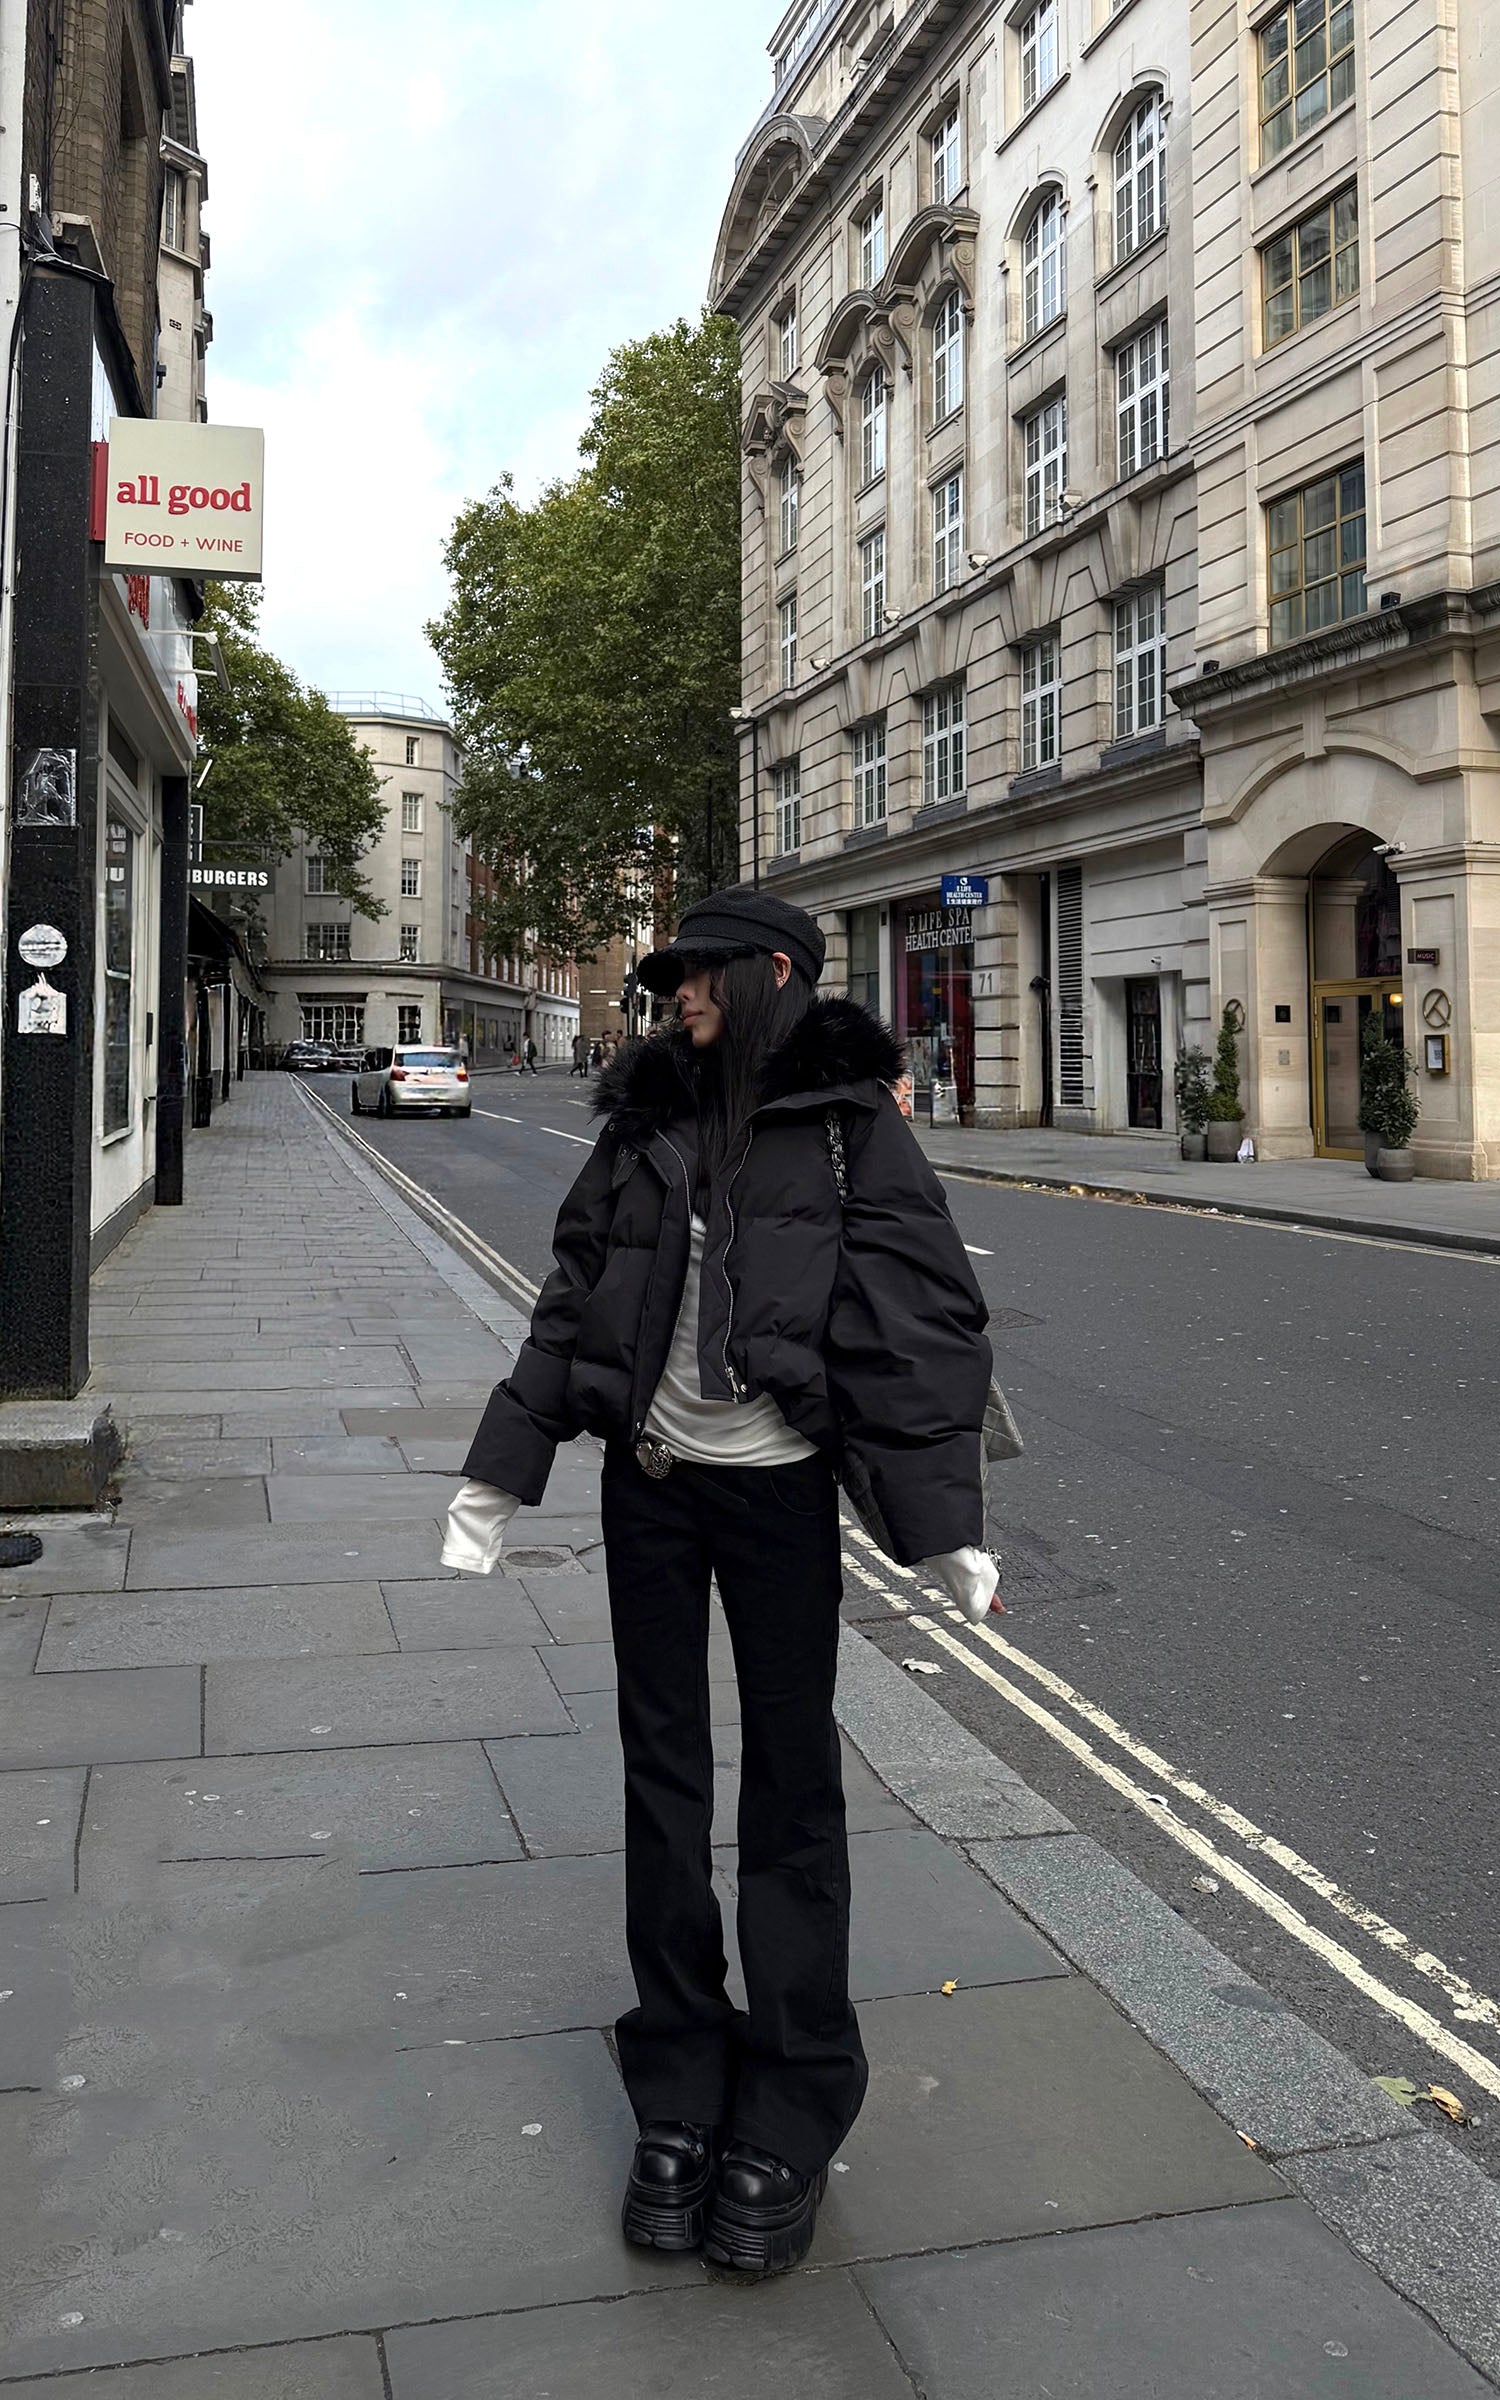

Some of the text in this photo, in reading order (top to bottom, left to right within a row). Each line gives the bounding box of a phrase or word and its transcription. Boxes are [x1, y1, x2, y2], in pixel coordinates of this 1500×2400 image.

[116, 475, 252, 515] all good
[124, 532, 243, 553] FOOD + WINE
[187, 868, 269, 887] BURGERS
[909, 907, 970, 934] E LIFE SPA
[905, 930, 939, 952] HEALTH
[979, 972, 993, 994] 71
